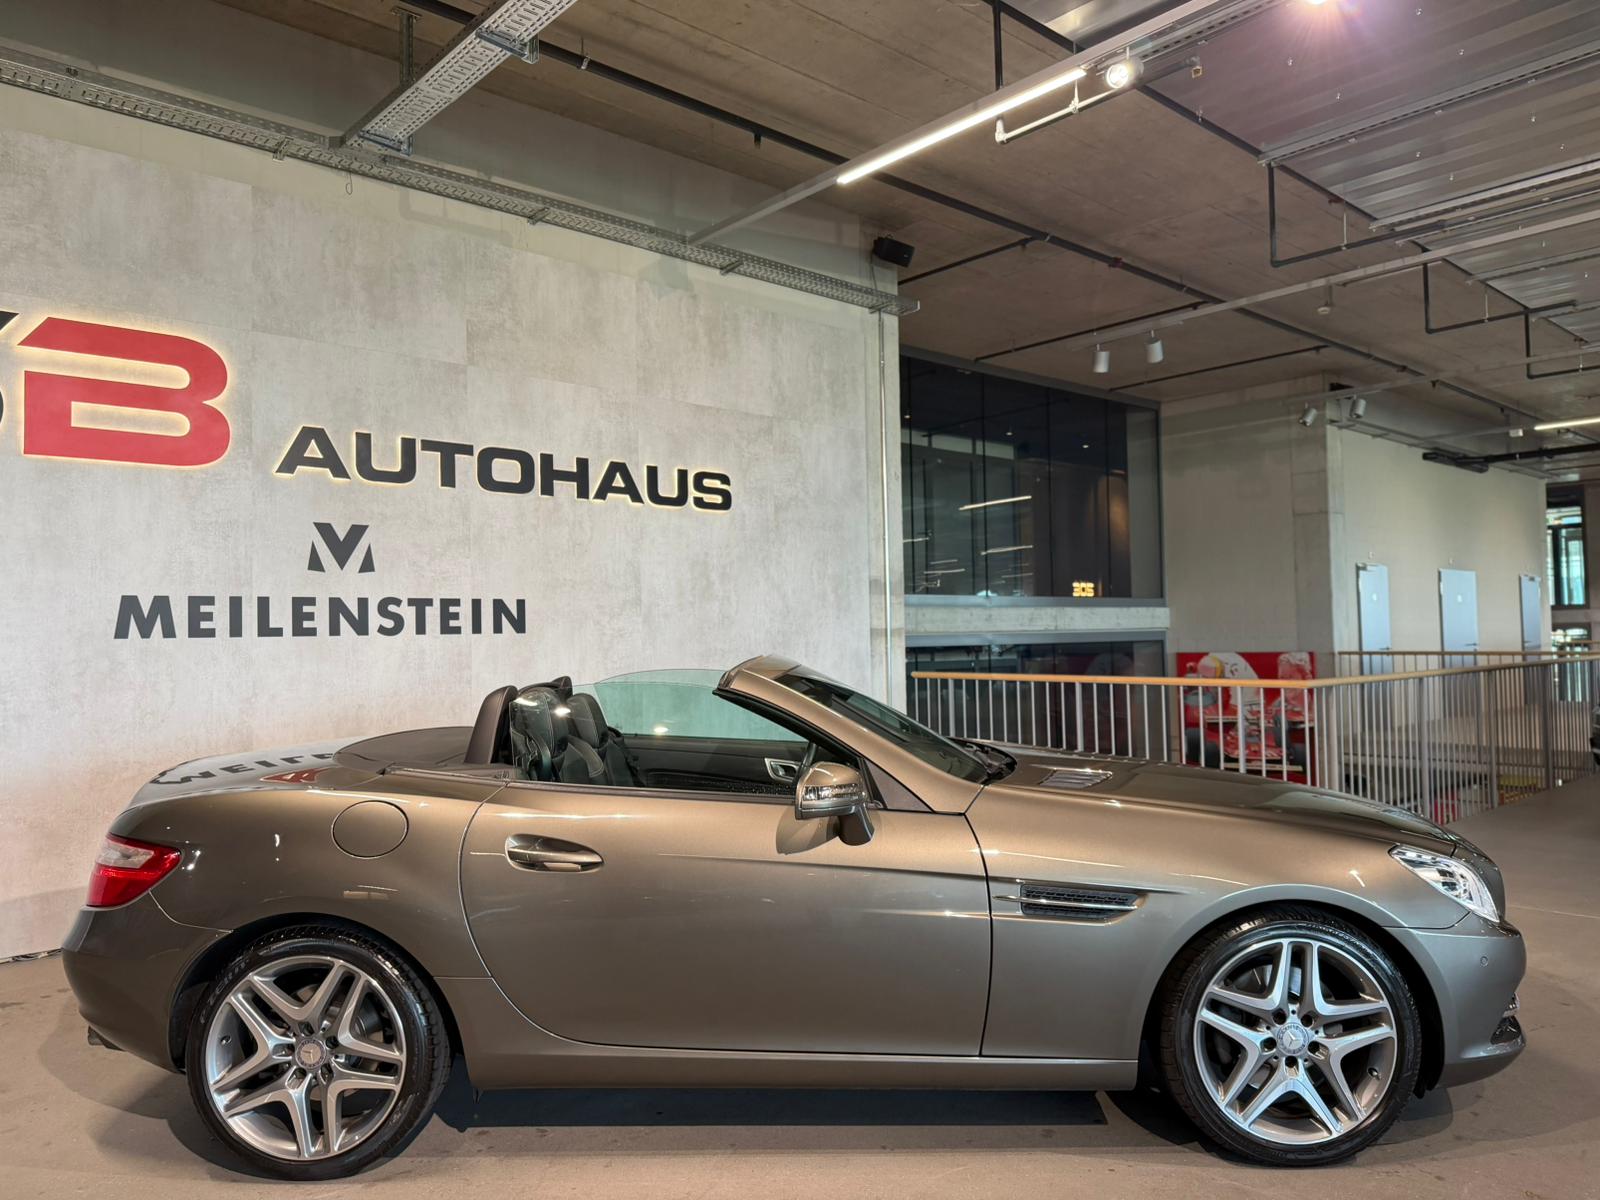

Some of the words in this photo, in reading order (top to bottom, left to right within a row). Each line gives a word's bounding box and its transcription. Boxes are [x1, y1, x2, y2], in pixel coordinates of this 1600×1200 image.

[0, 310, 231, 467] B
[274, 425, 732, 511] AUTOHAUS
[113, 594, 527, 640] MEILENSTEIN
